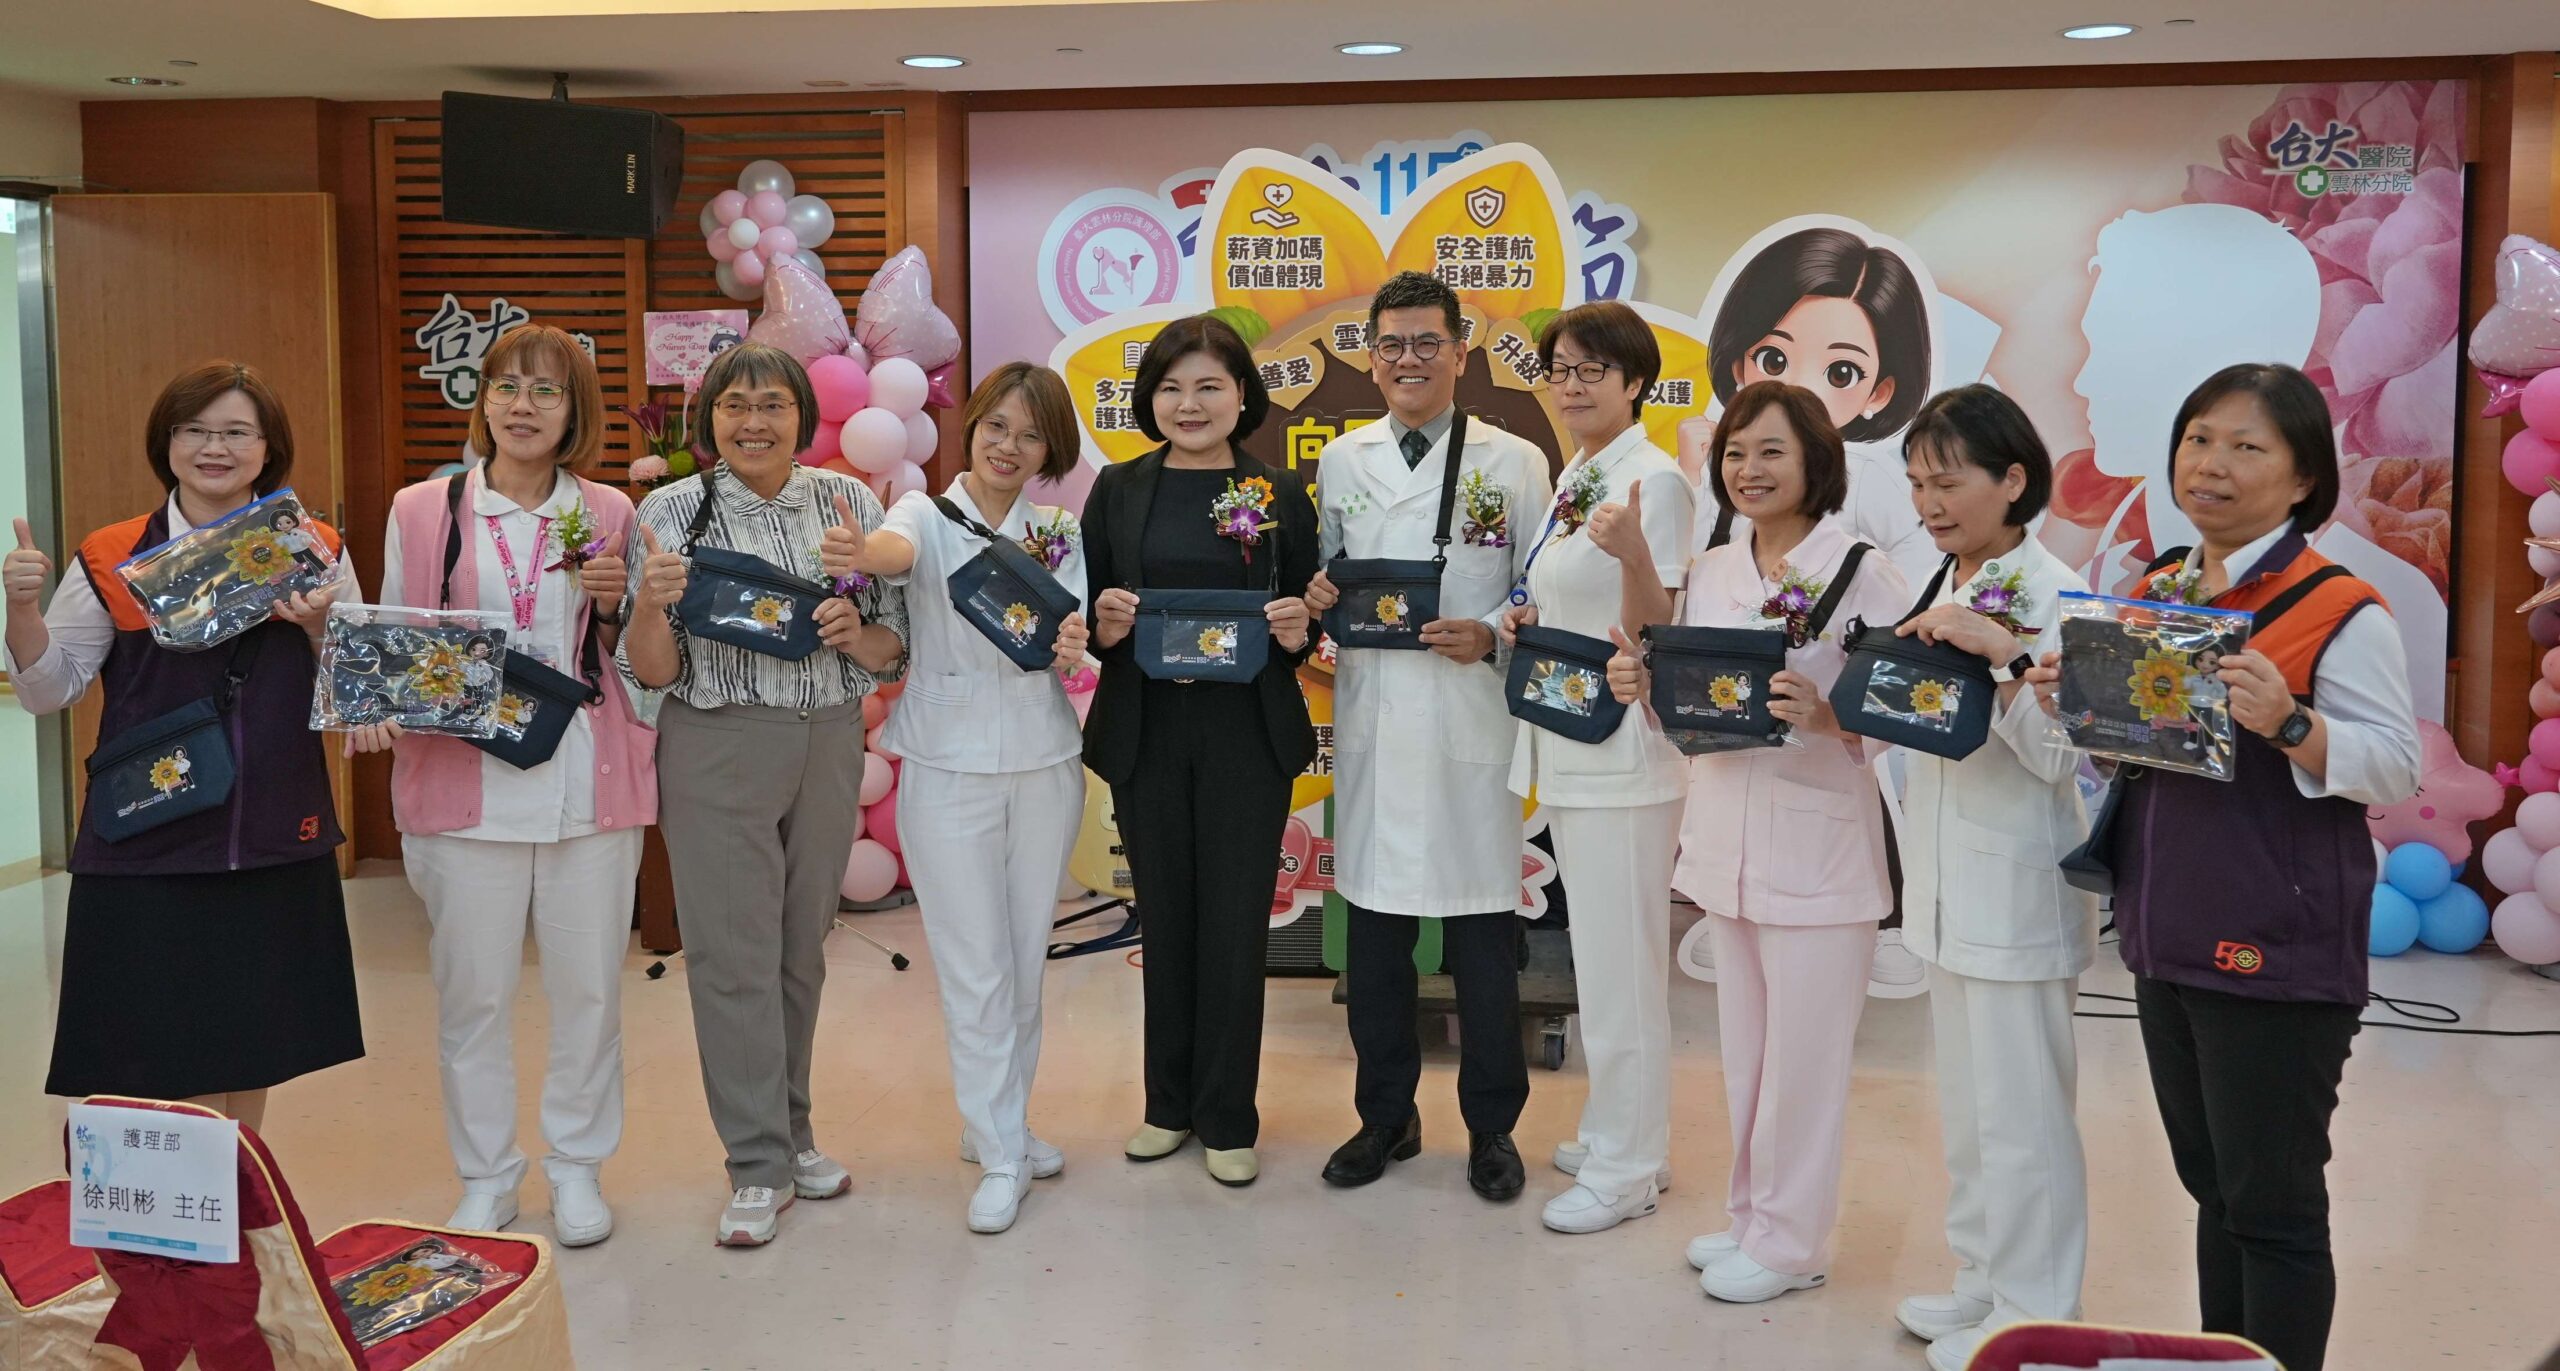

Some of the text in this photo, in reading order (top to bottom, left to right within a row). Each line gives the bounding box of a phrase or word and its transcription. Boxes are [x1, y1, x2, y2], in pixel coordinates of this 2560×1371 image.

[2330, 174, 2412, 193] 雲林分院
[1227, 236, 1323, 260] 薪資加碼
[1436, 236, 1534, 261] 安全護航
[1227, 264, 1323, 289] 價值體現
[1438, 264, 1533, 289] 拒絕暴力
[664, 333, 695, 342] Happy
[1493, 333, 1543, 385] 升級
[1260, 357, 1313, 389] 善愛
[1095, 407, 1140, 430] 護理
[2214, 941, 2263, 974] 50
[123, 1128, 181, 1152] 護理部
[83, 1183, 222, 1222] 徐則彬 主任
